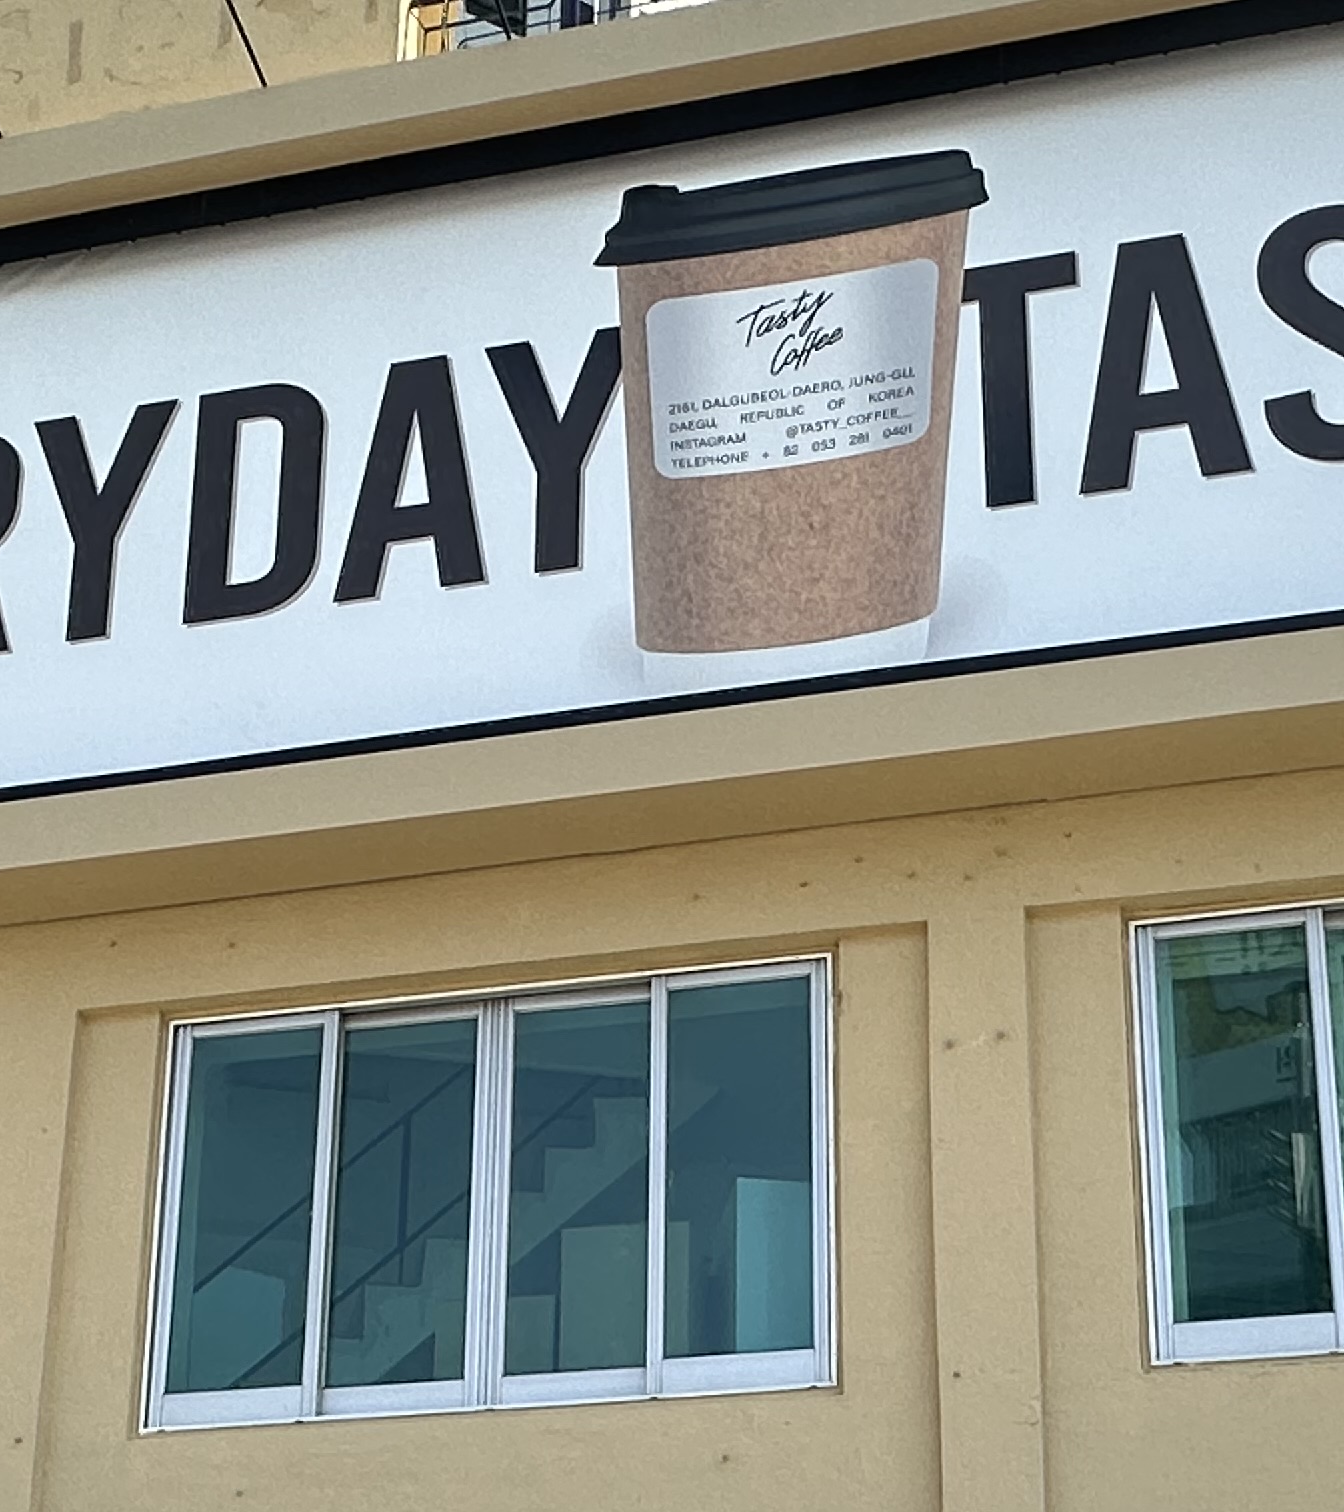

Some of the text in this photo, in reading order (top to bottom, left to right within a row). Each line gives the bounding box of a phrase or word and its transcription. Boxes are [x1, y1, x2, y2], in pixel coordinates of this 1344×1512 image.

[736, 289, 834, 347] Tasty
[770, 327, 843, 376] Coffee
[826, 397, 846, 411] OF
[868, 386, 915, 404] KOREA
[670, 432, 747, 452] INSTAGRAM
[671, 450, 749, 470] TELEPHONE
